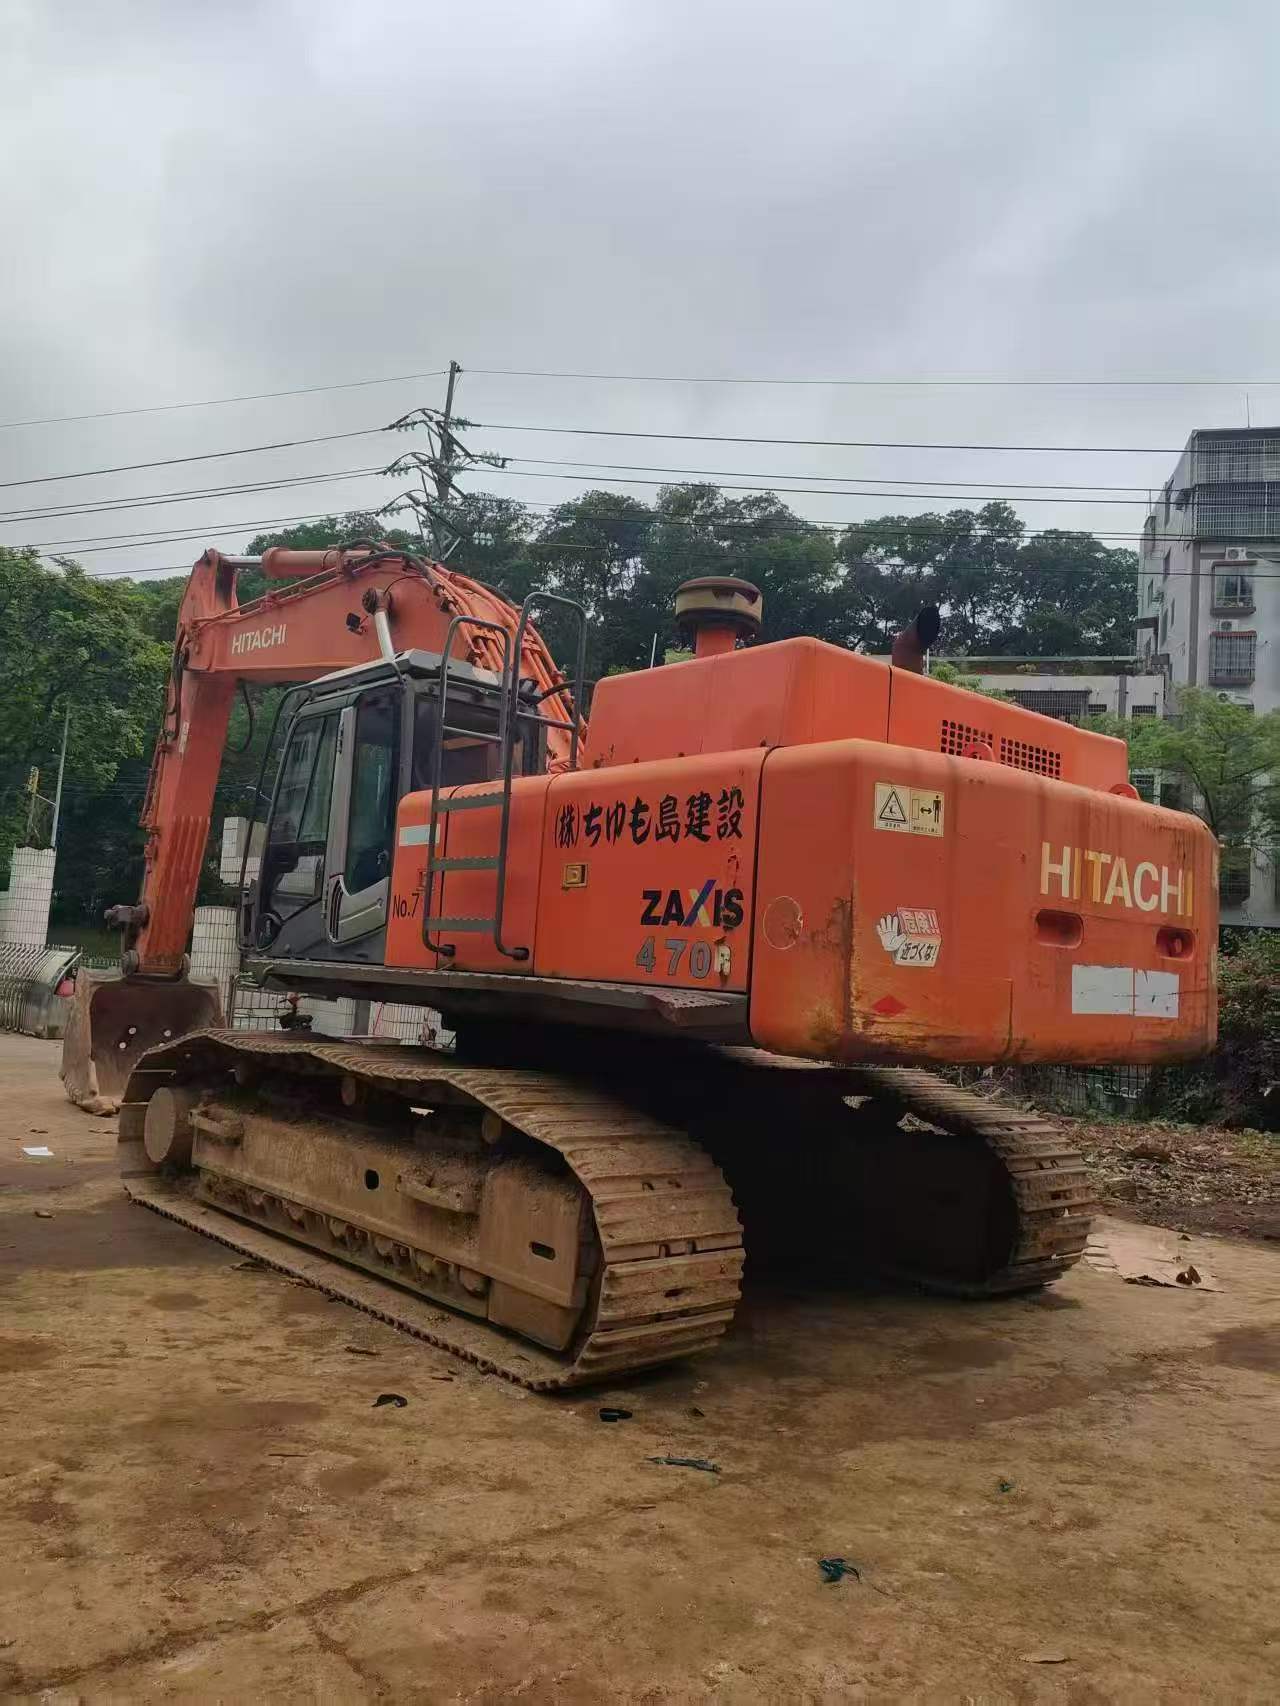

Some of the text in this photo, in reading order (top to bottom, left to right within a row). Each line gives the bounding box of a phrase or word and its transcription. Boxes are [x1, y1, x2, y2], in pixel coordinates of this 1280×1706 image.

[231, 624, 287, 655] HITACHI
[1040, 842, 1193, 917] HITACHI
[392, 893, 420, 918] No.7
[640, 879, 744, 928] ZAXIS
